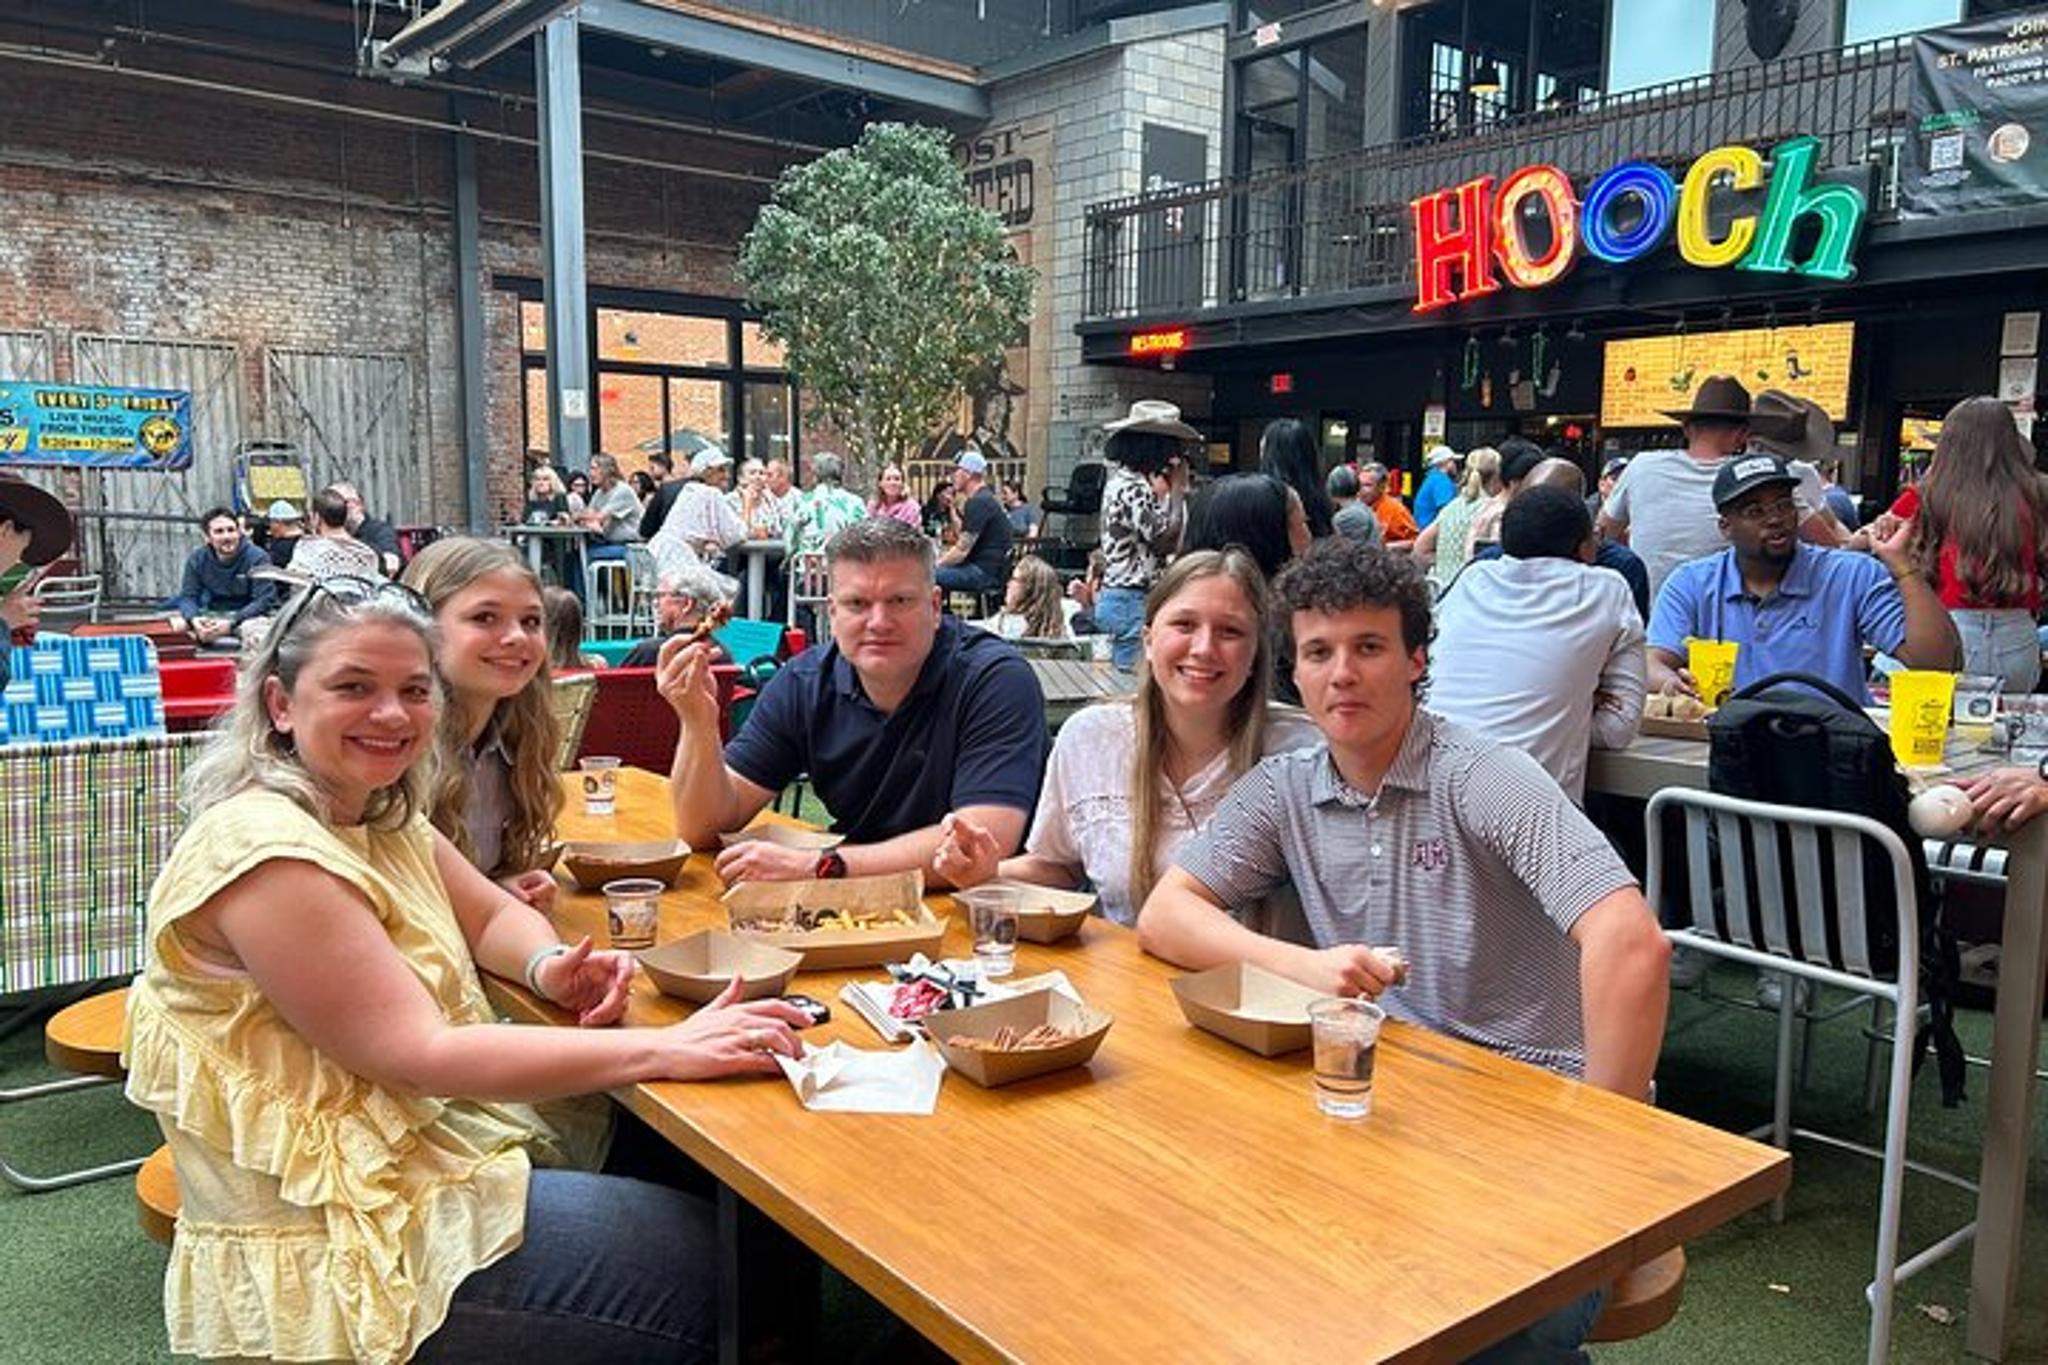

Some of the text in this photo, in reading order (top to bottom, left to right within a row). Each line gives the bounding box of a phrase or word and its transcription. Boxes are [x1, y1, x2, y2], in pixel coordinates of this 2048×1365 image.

[1937, 53, 1962, 69] ST.
[951, 128, 1020, 170] OST
[963, 159, 1033, 226] TED
[36, 391, 90, 408] EVERY
[49, 412, 125, 423] LIVE MUSIC
[40, 424, 78, 433] FROM
[82, 424, 107, 434] THE
